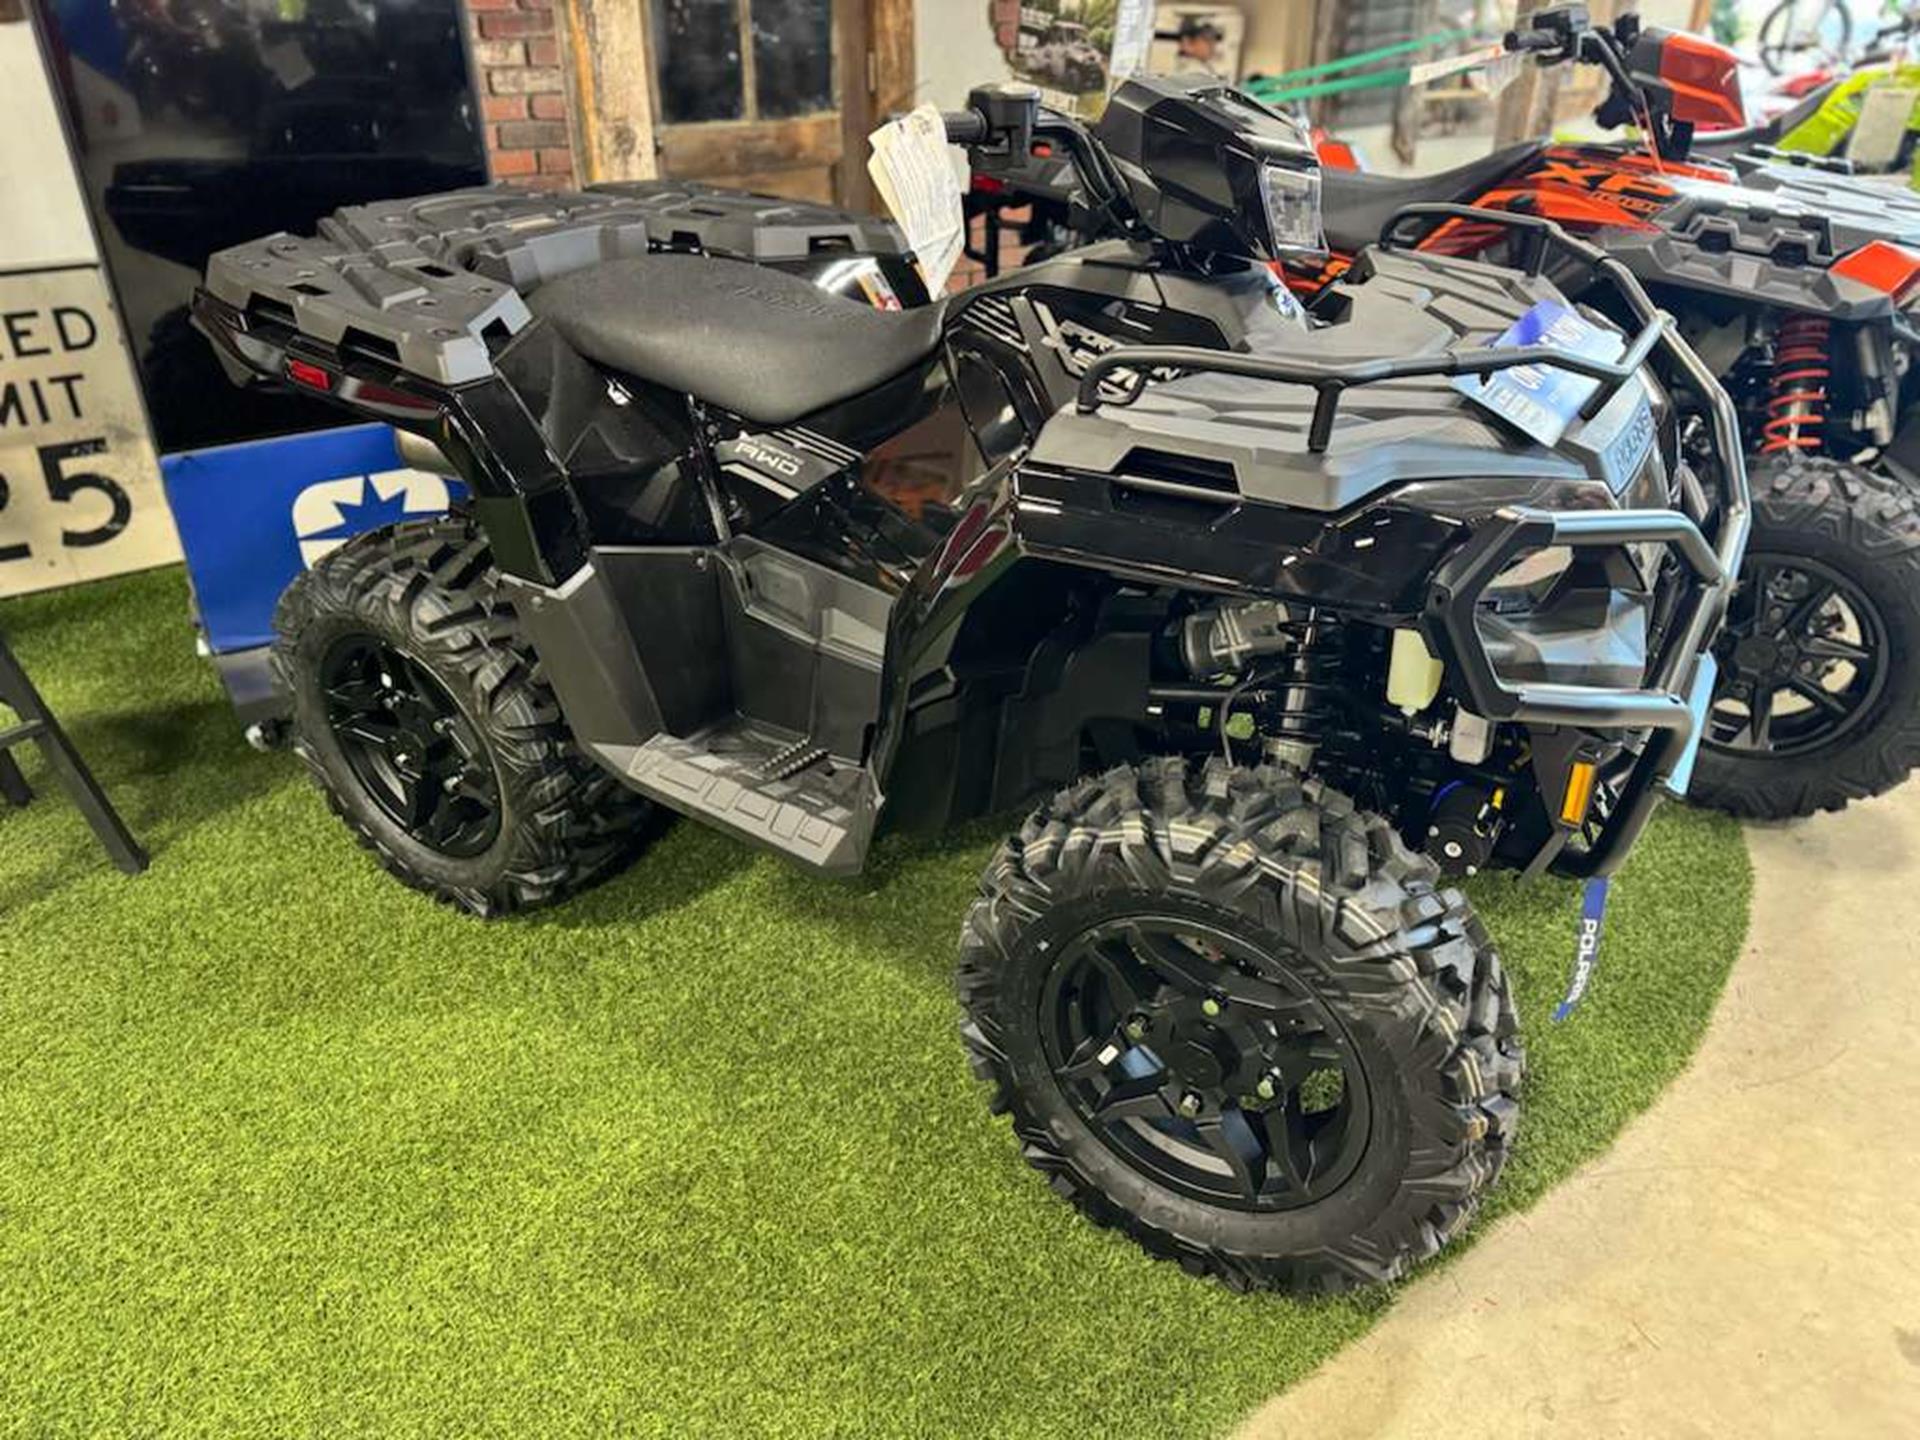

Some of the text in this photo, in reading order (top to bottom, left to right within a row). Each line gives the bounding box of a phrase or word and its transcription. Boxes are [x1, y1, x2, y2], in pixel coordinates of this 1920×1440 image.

[1526, 160, 1678, 197] XP
[0, 306, 97, 358] ED
[734, 442, 799, 476] AWD
